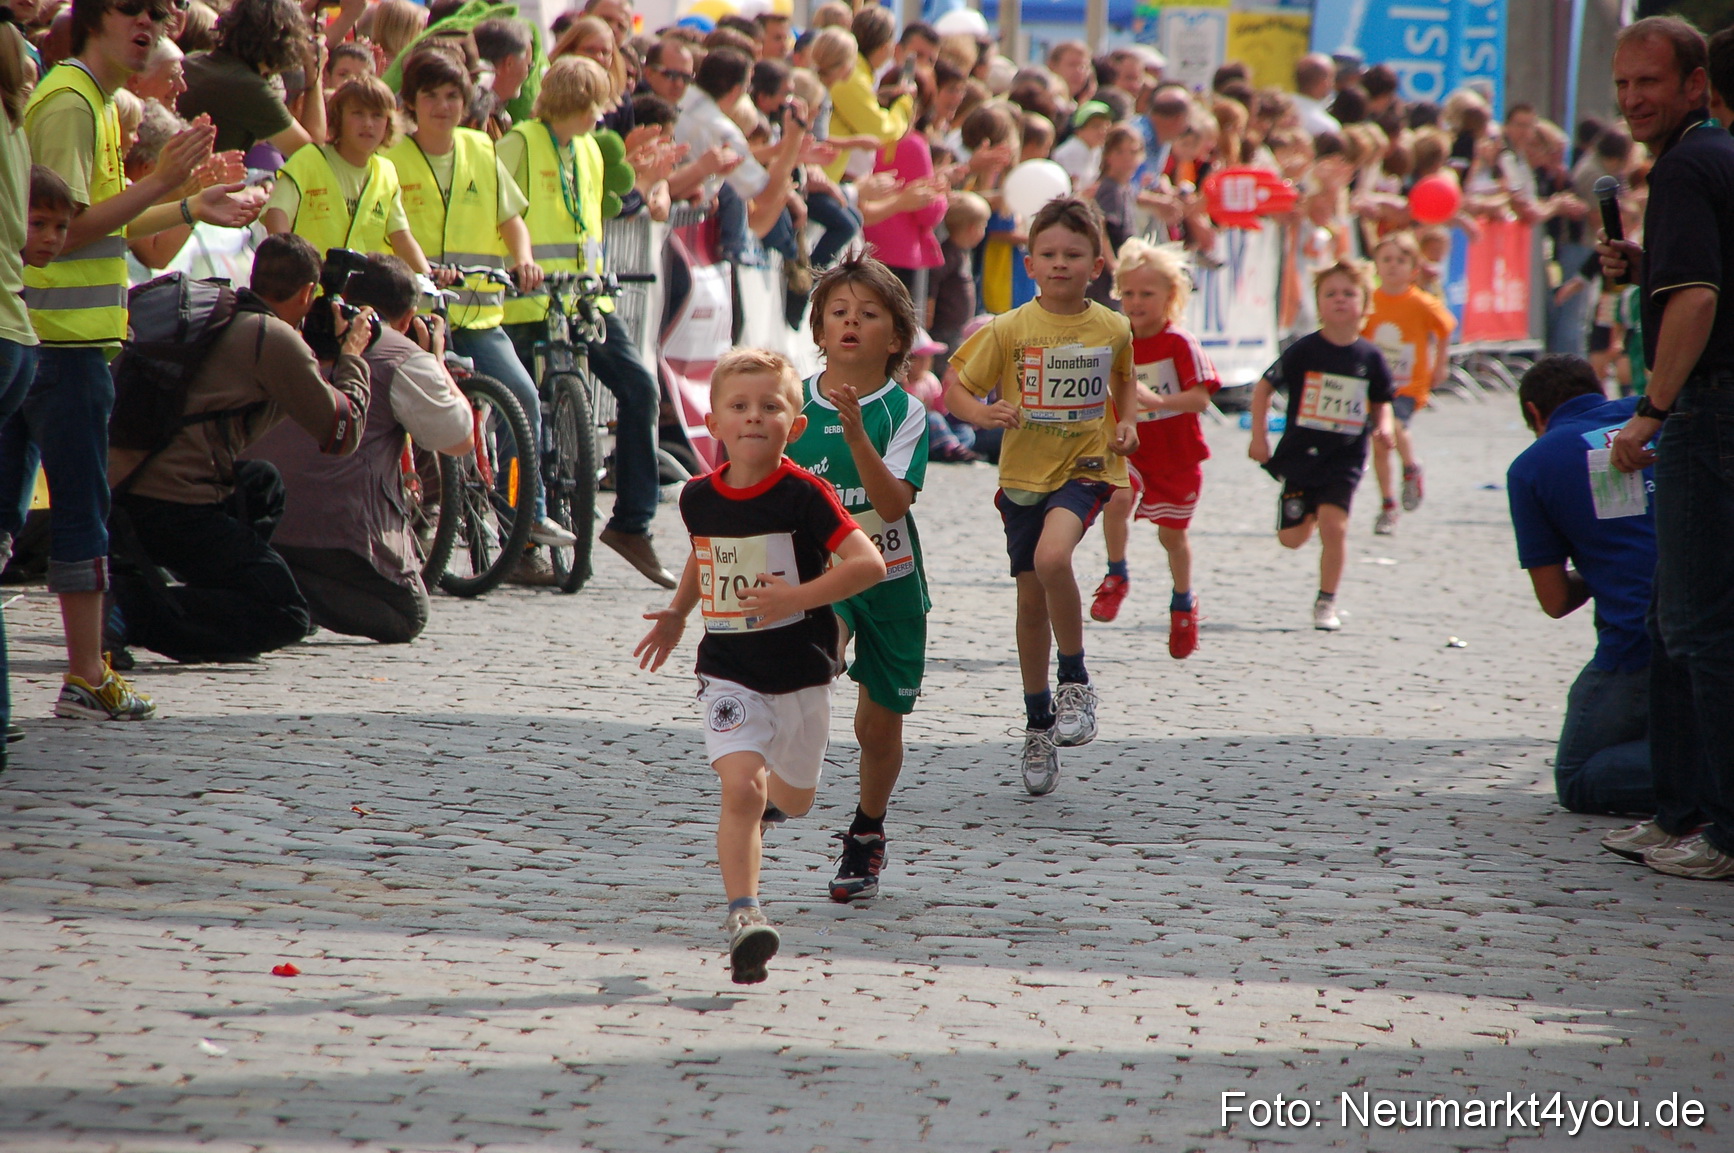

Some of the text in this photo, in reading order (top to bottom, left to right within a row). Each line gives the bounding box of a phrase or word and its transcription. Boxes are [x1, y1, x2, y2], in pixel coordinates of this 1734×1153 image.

[1047, 355, 1100, 370] Jonathan
[1026, 376, 1037, 387] K2
[1048, 376, 1103, 399] 7200
[1321, 395, 1362, 416] 7114
[336, 420, 347, 440] EOS
[1023, 421, 1041, 431] JET
[809, 456, 830, 474] ort
[870, 528, 901, 555] 38
[715, 545, 738, 564] Karl
[887, 561, 914, 575] EIDERER
[701, 573, 710, 586] K2
